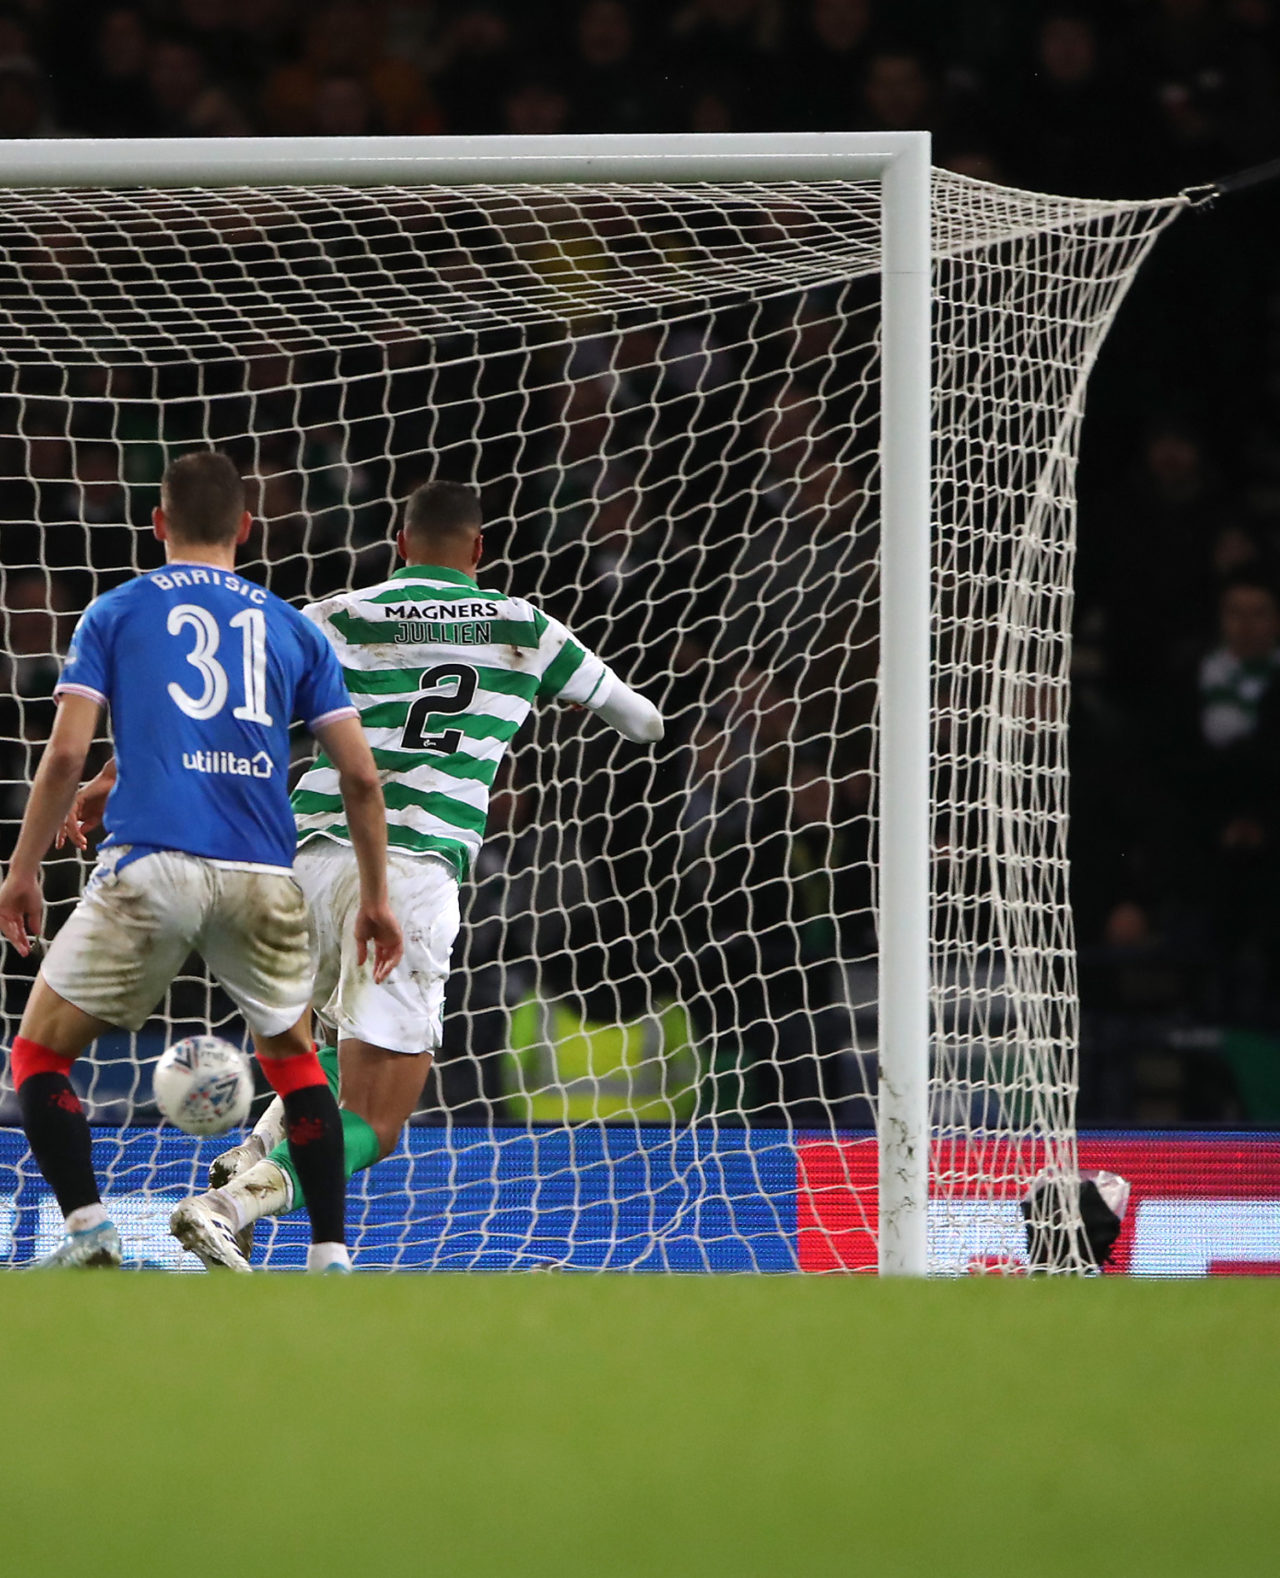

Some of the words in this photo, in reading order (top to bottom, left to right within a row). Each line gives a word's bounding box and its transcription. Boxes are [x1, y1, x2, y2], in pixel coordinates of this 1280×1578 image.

[150, 569, 268, 605] BARISIC
[384, 602, 498, 620] MAGNERS
[394, 621, 492, 644] JULLIEN
[167, 603, 273, 727] 31
[400, 662, 479, 757] 2
[182, 751, 252, 777] utilita
